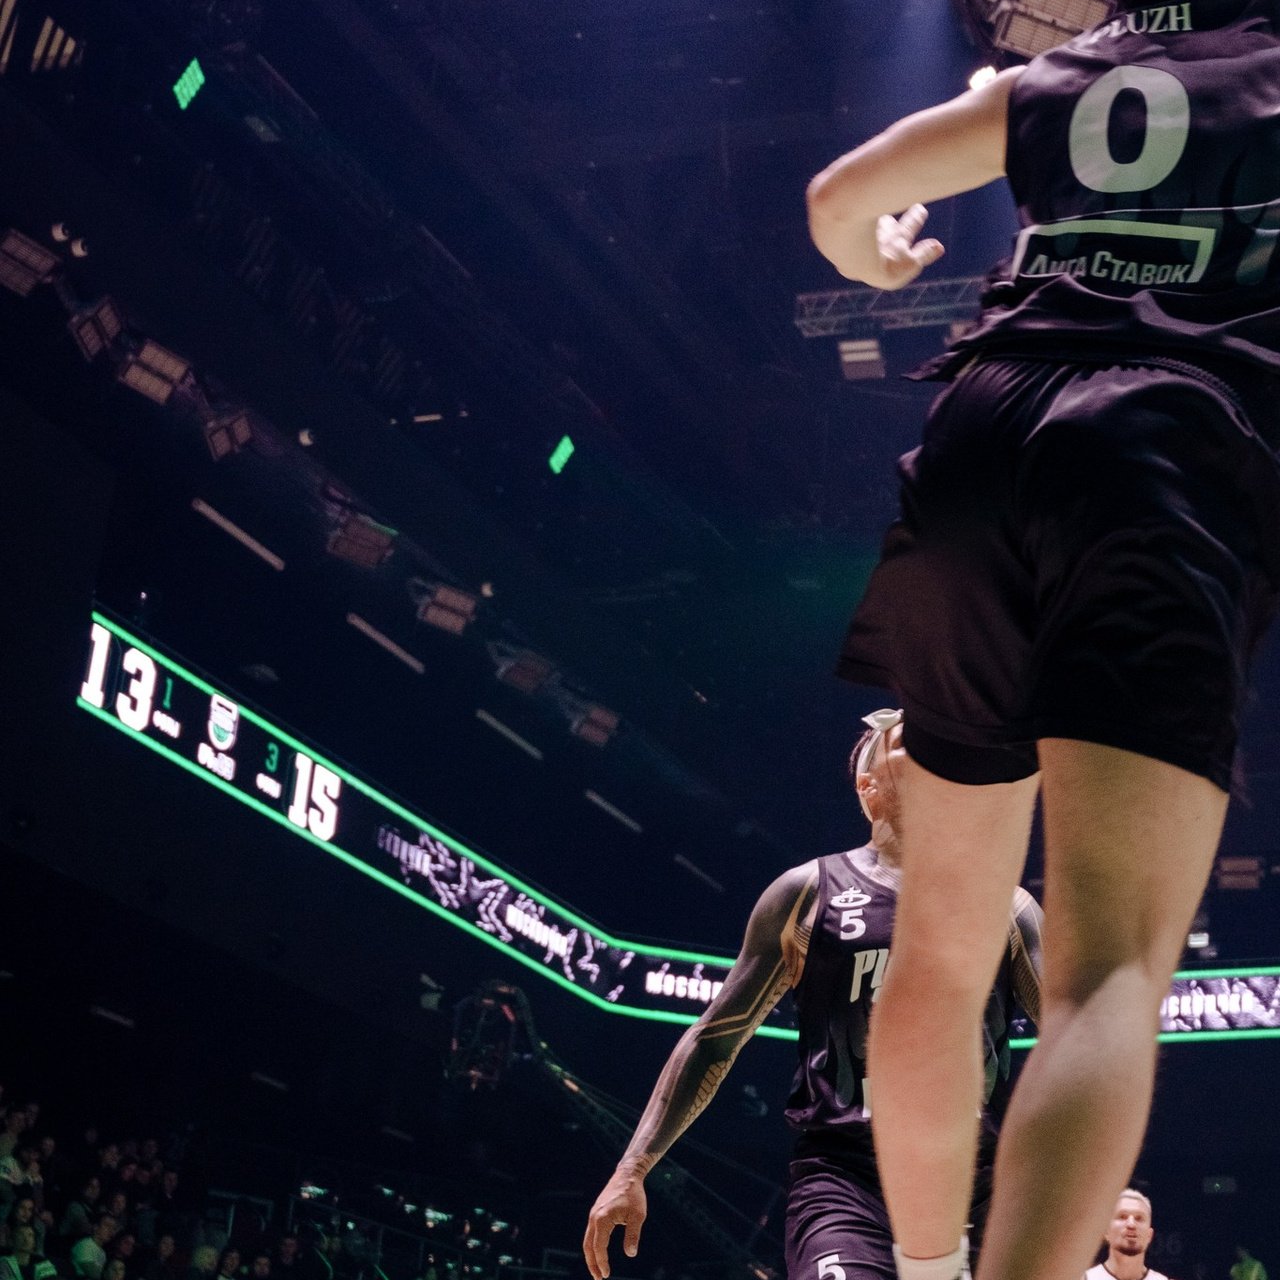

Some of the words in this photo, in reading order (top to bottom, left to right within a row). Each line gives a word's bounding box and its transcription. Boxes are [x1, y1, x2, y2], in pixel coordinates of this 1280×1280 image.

[1068, 64, 1191, 194] 0
[1090, 250, 1192, 286] СТАВОК
[80, 622, 157, 732] 13
[287, 751, 342, 842] 15
[838, 909, 867, 940] 5
